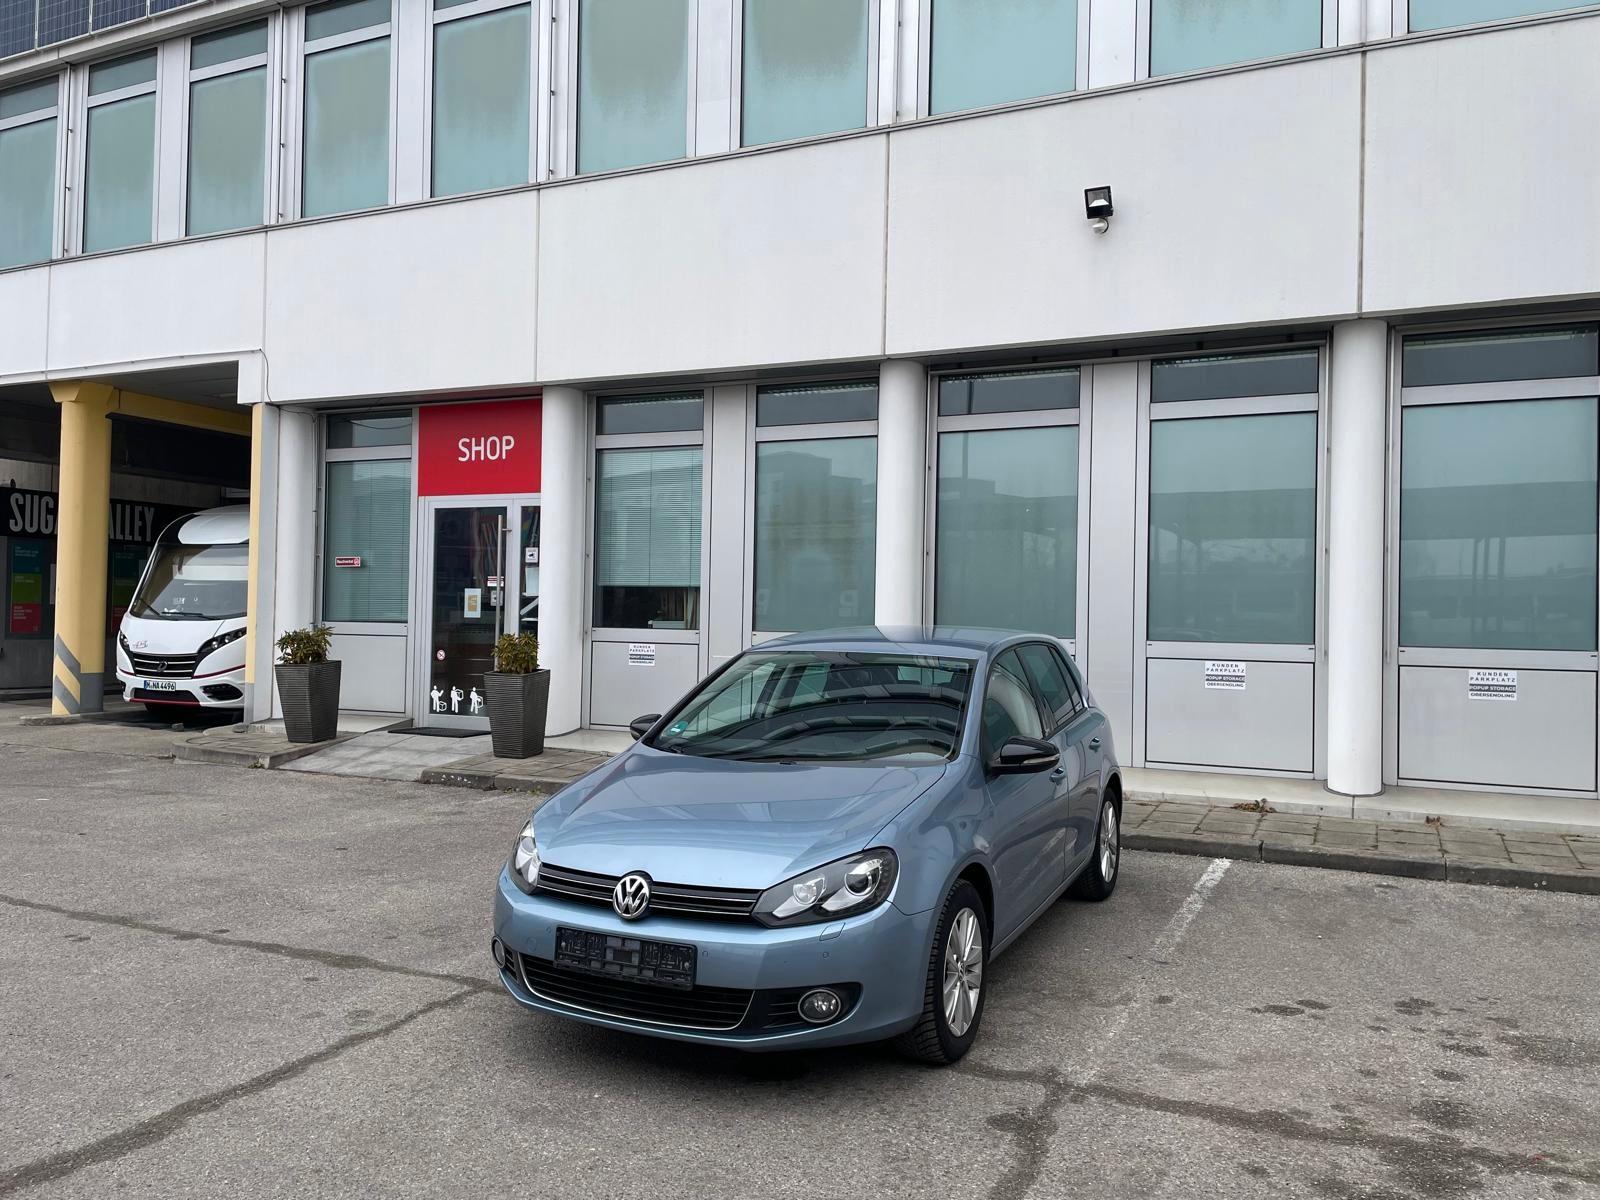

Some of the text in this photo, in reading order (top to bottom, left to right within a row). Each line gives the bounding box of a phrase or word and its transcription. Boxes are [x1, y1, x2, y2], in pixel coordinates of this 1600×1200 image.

[458, 435, 515, 462] SHOP
[9, 492, 58, 535] SUG
[160, 683, 175, 691] 4496
